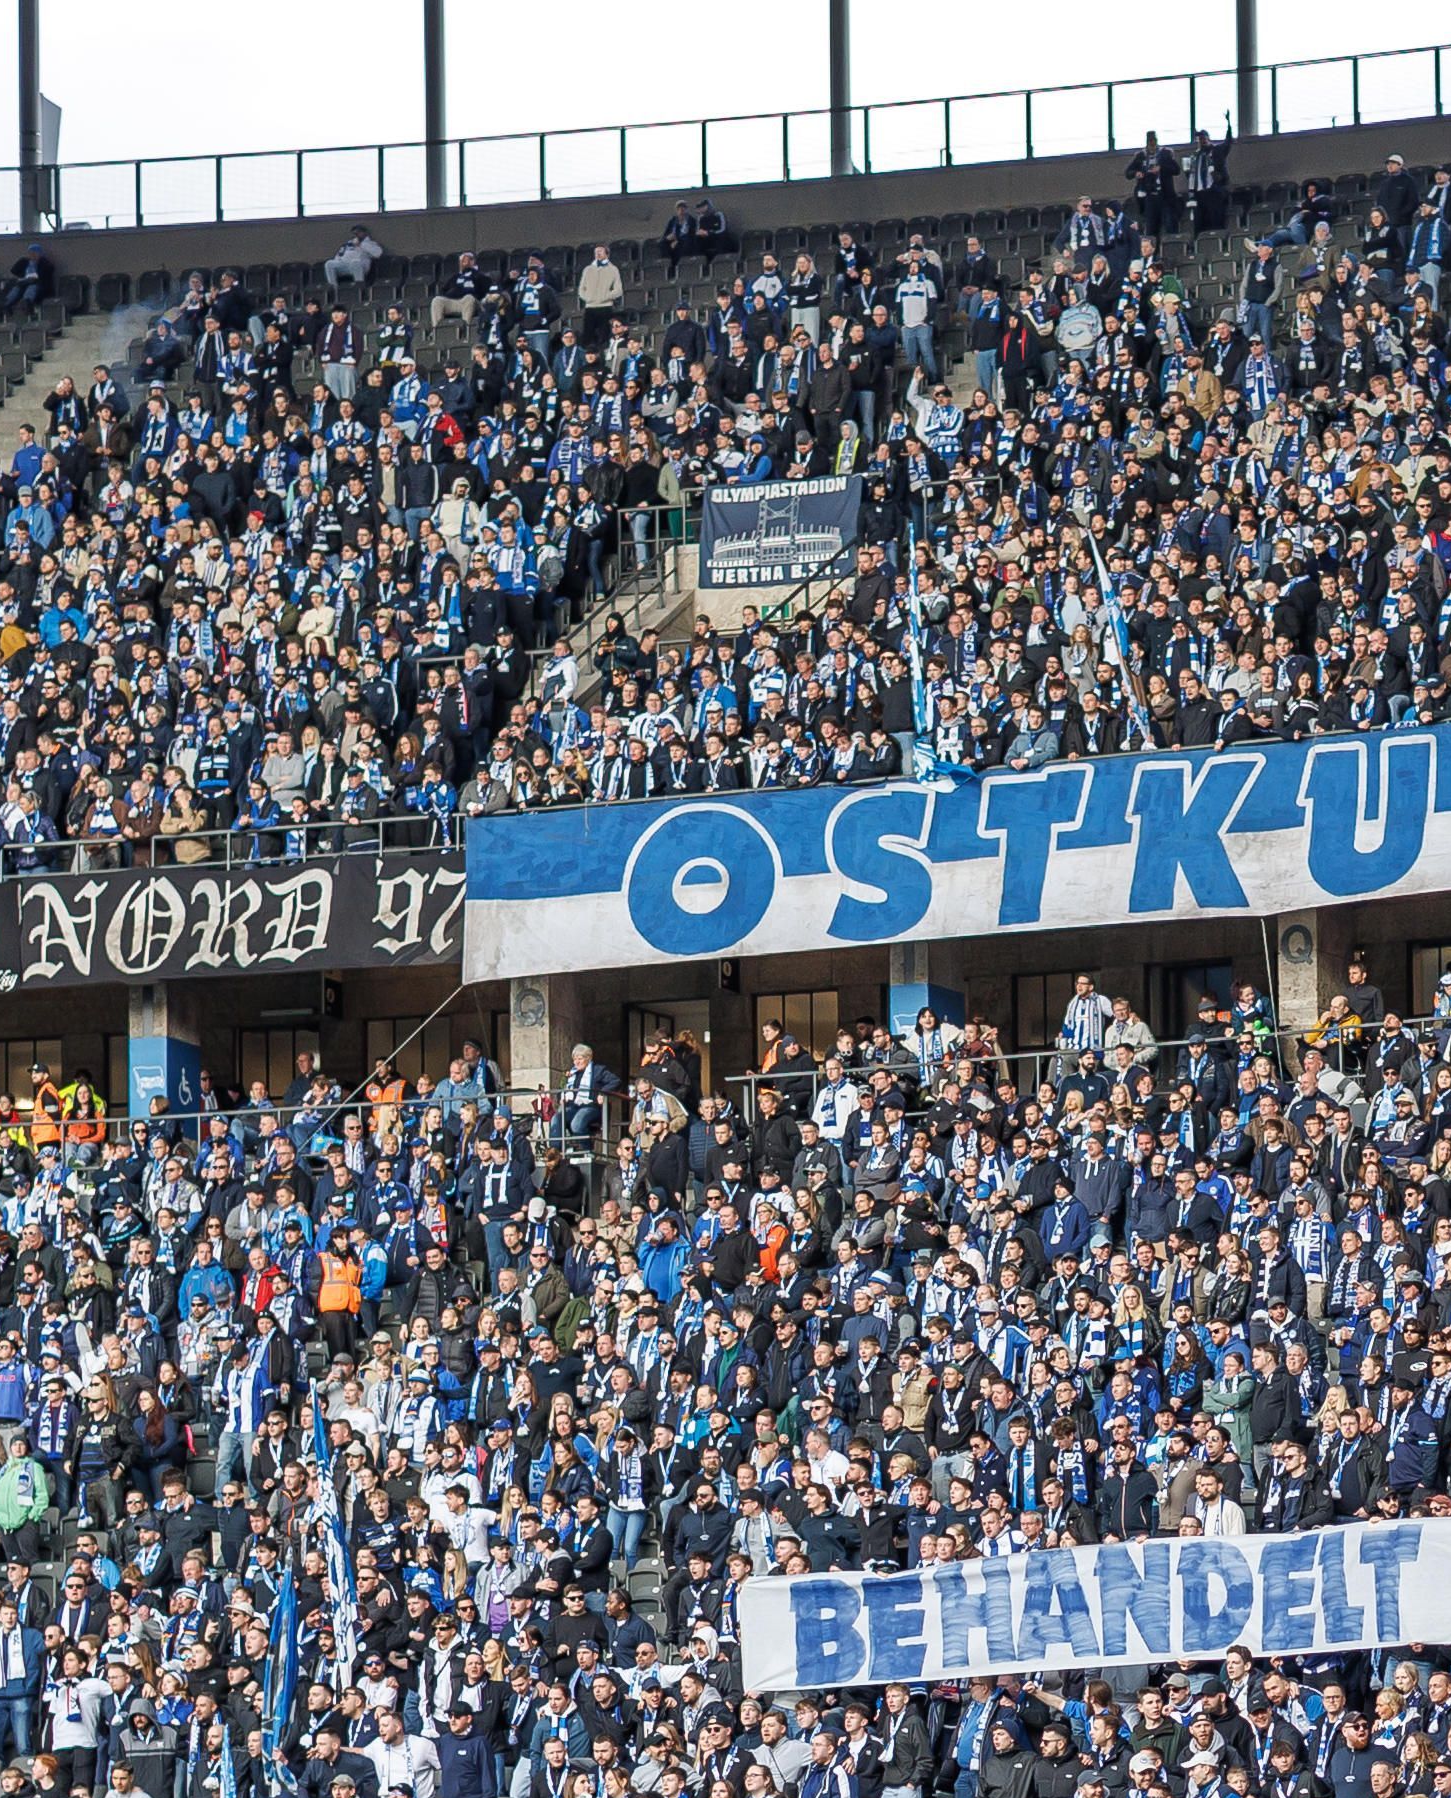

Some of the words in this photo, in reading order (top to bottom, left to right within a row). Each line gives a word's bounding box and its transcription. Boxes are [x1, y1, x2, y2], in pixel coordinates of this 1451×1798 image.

[711, 476, 847, 504] OLYMPIASTADION
[711, 566, 784, 584] HERTHA
[21, 866, 335, 983] NORD
[1280, 924, 1314, 966] Q
[513, 987, 547, 1030] Q
[789, 1526, 1422, 1687] BEHANDELT
